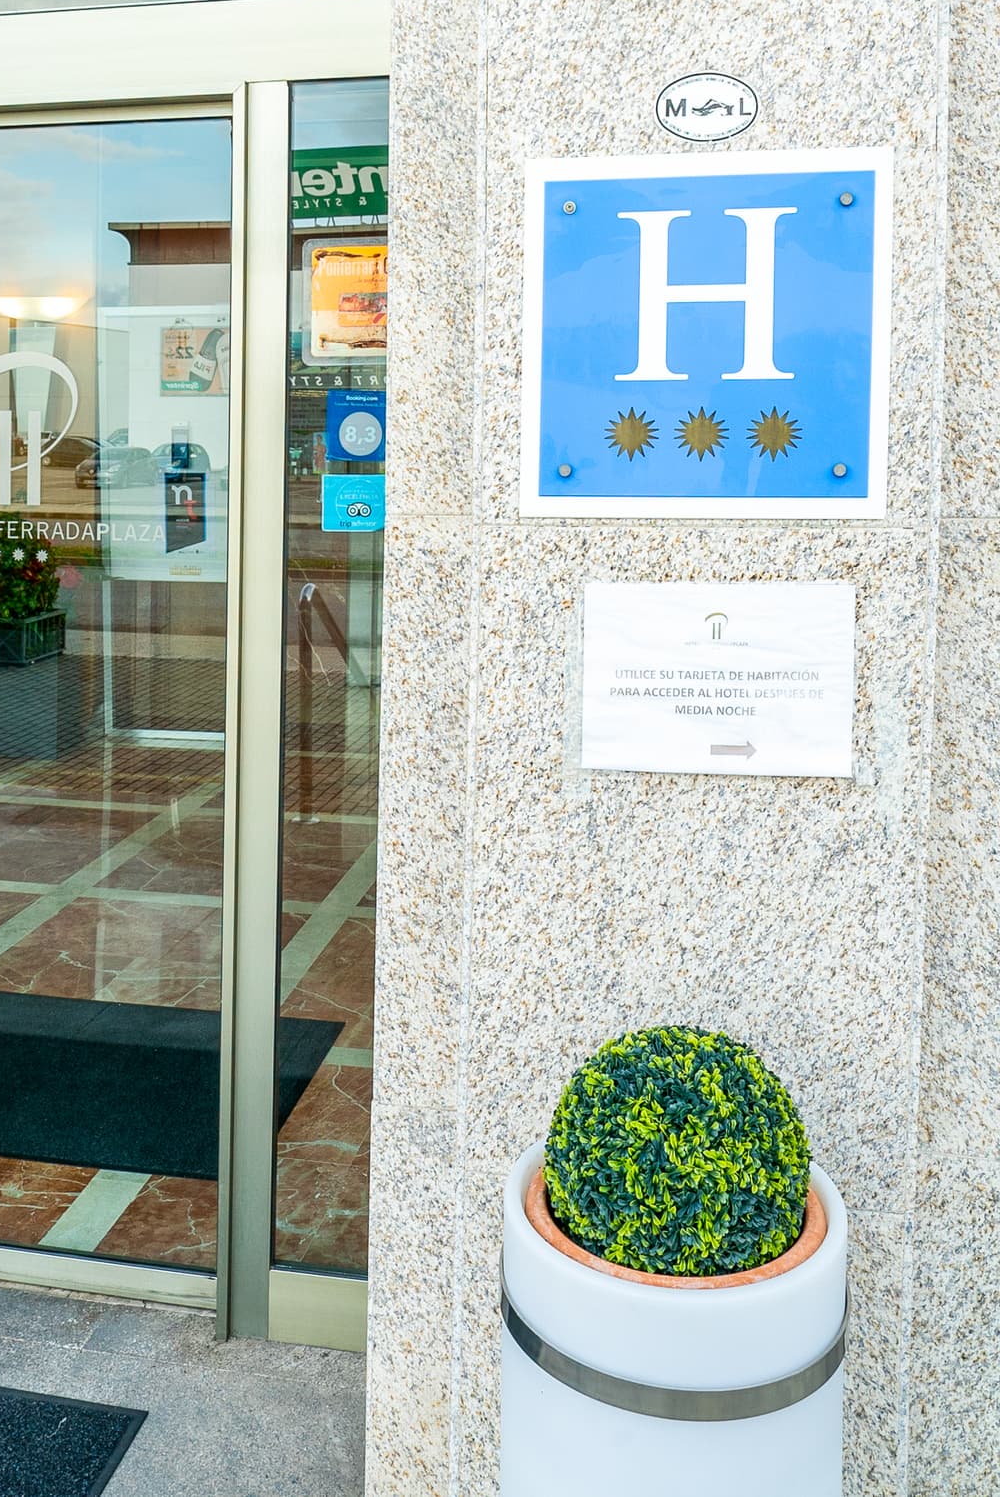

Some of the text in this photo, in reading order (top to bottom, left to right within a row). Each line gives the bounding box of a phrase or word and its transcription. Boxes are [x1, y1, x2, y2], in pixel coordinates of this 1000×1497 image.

[613, 206, 798, 381] H
[344, 426, 377, 445] 8,3
[615, 669, 820, 681] UTILICE SU TARJETA DE HABITACIÓN
[609, 687, 641, 697] PARA
[643, 687, 695, 698] ACCEDER
[697, 688, 712, 698] AL
[714, 688, 752, 698] HOTEL
[675, 705, 757, 716] MEDIA NOCHE
